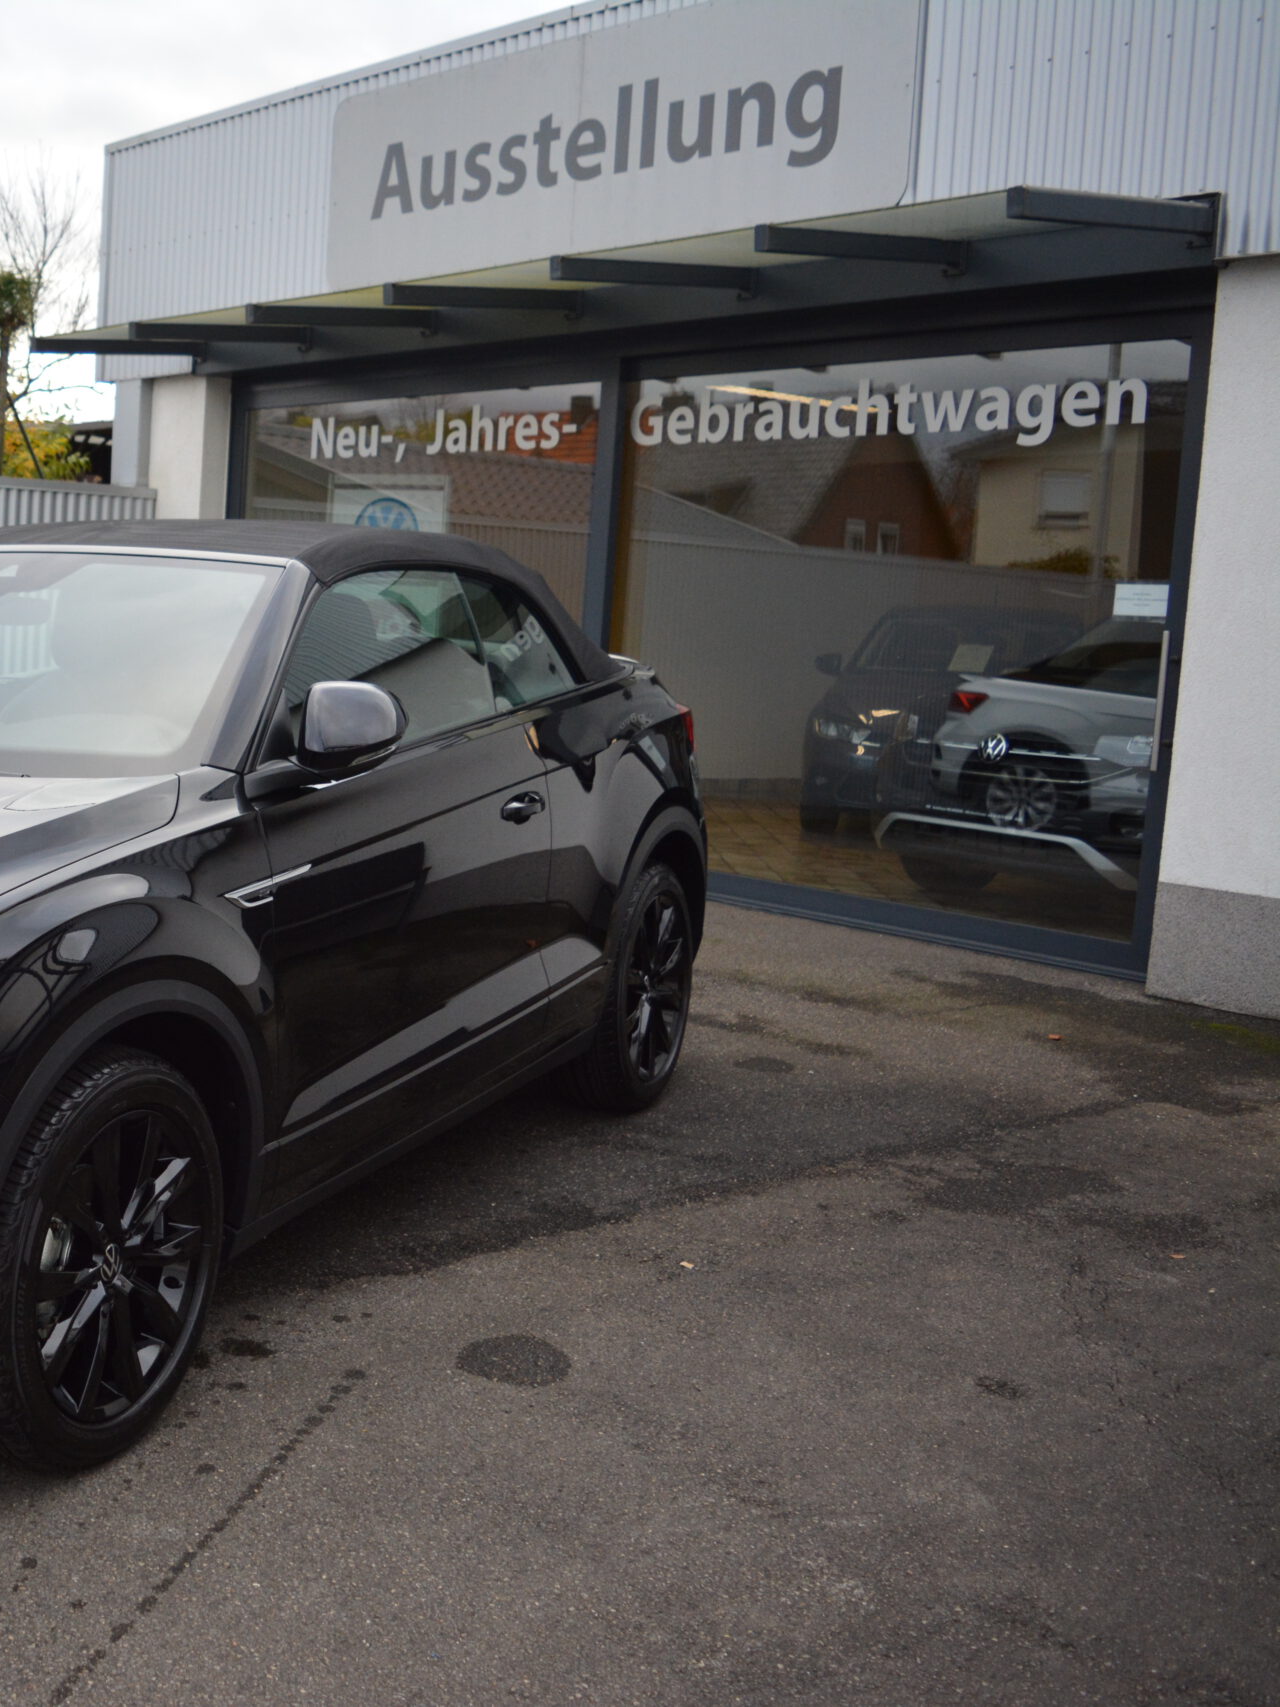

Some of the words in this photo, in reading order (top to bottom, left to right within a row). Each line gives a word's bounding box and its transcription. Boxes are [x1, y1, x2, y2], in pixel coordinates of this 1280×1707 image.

[371, 65, 843, 220] Ausstellung
[310, 417, 407, 463] Neu-,
[426, 404, 577, 456] Jahres-
[631, 378, 1148, 447] Gebrauchtwagen
